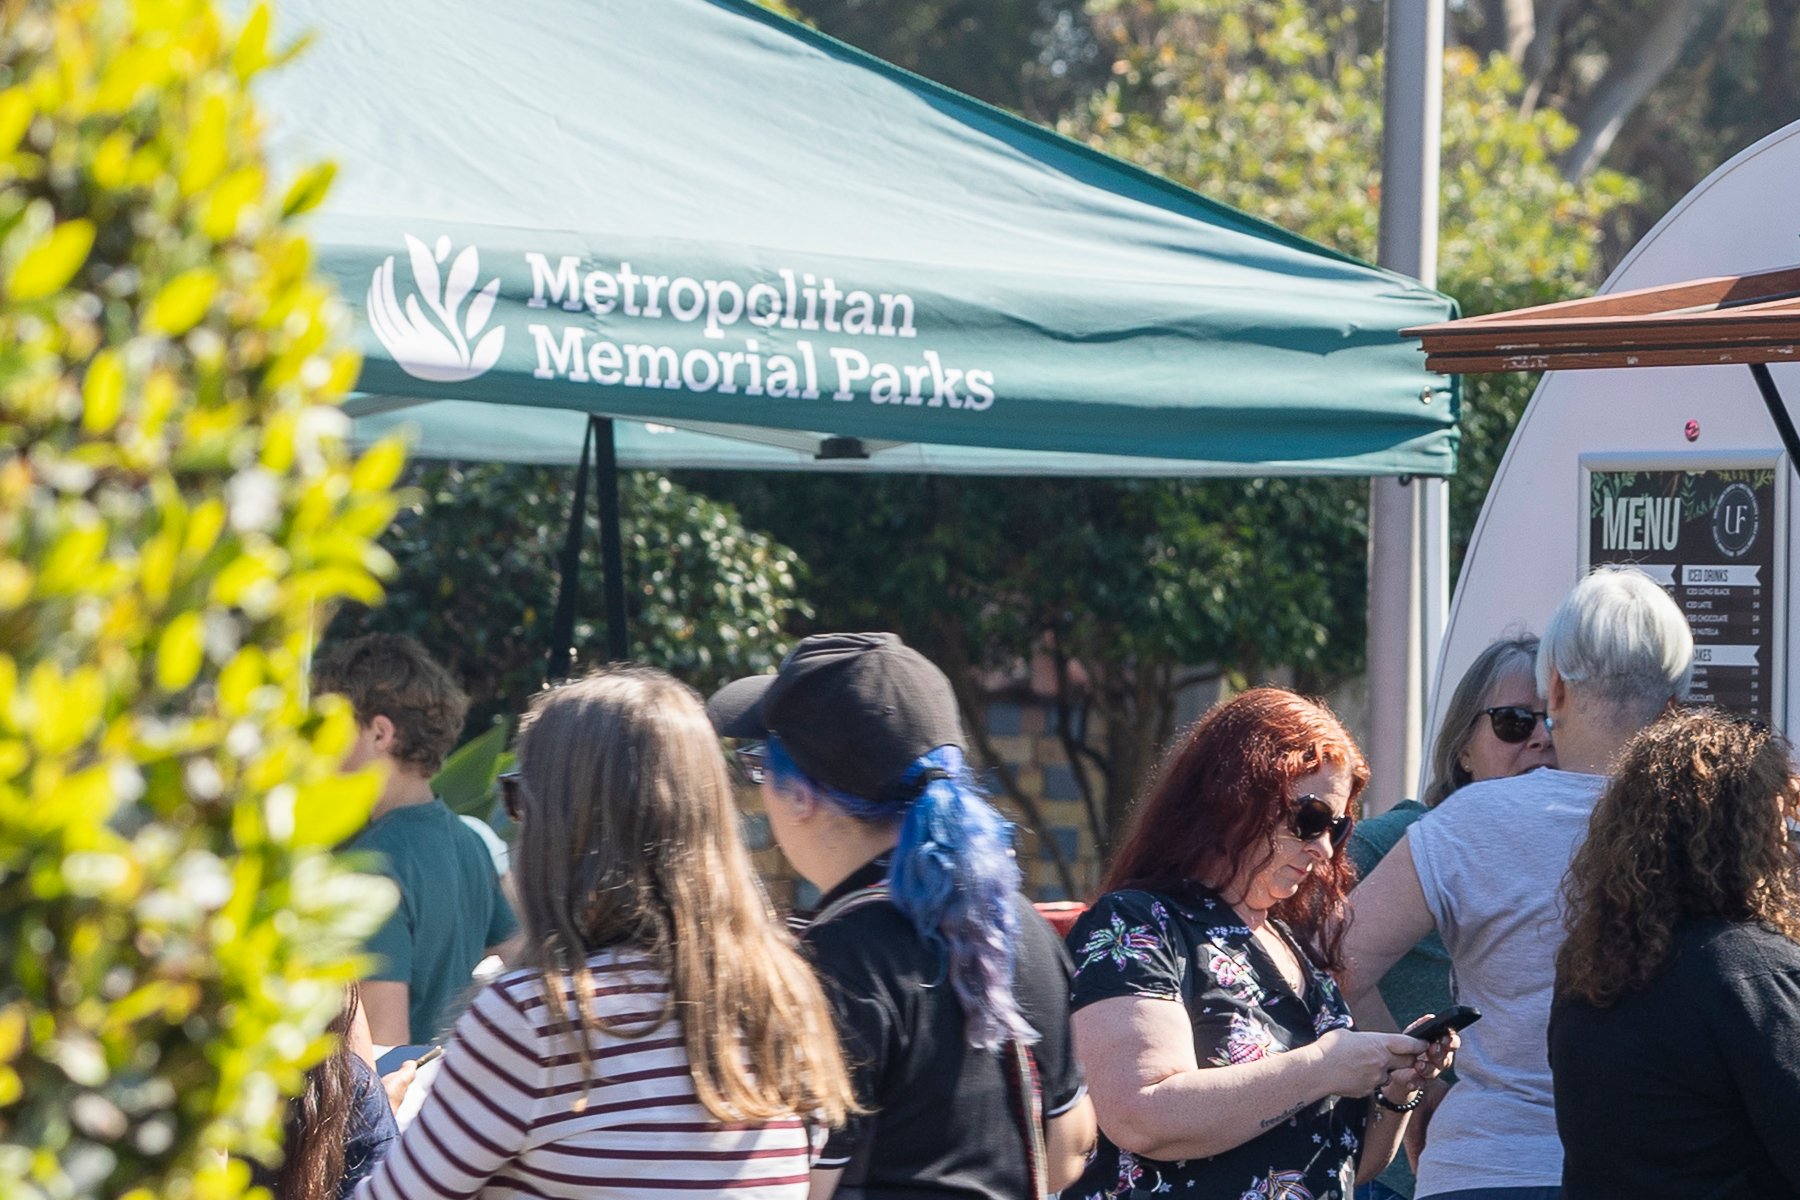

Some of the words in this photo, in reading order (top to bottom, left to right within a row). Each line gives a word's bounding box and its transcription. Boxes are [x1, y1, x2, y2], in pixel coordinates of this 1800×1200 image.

[525, 252, 917, 338] Metropolitan
[528, 324, 820, 400] Memorial
[829, 346, 996, 411] Parks
[1602, 497, 1681, 551] MENU
[1688, 569, 1702, 582] ICED
[1704, 569, 1728, 582] DRINKS
[1260, 1101, 1304, 1128] freedom
